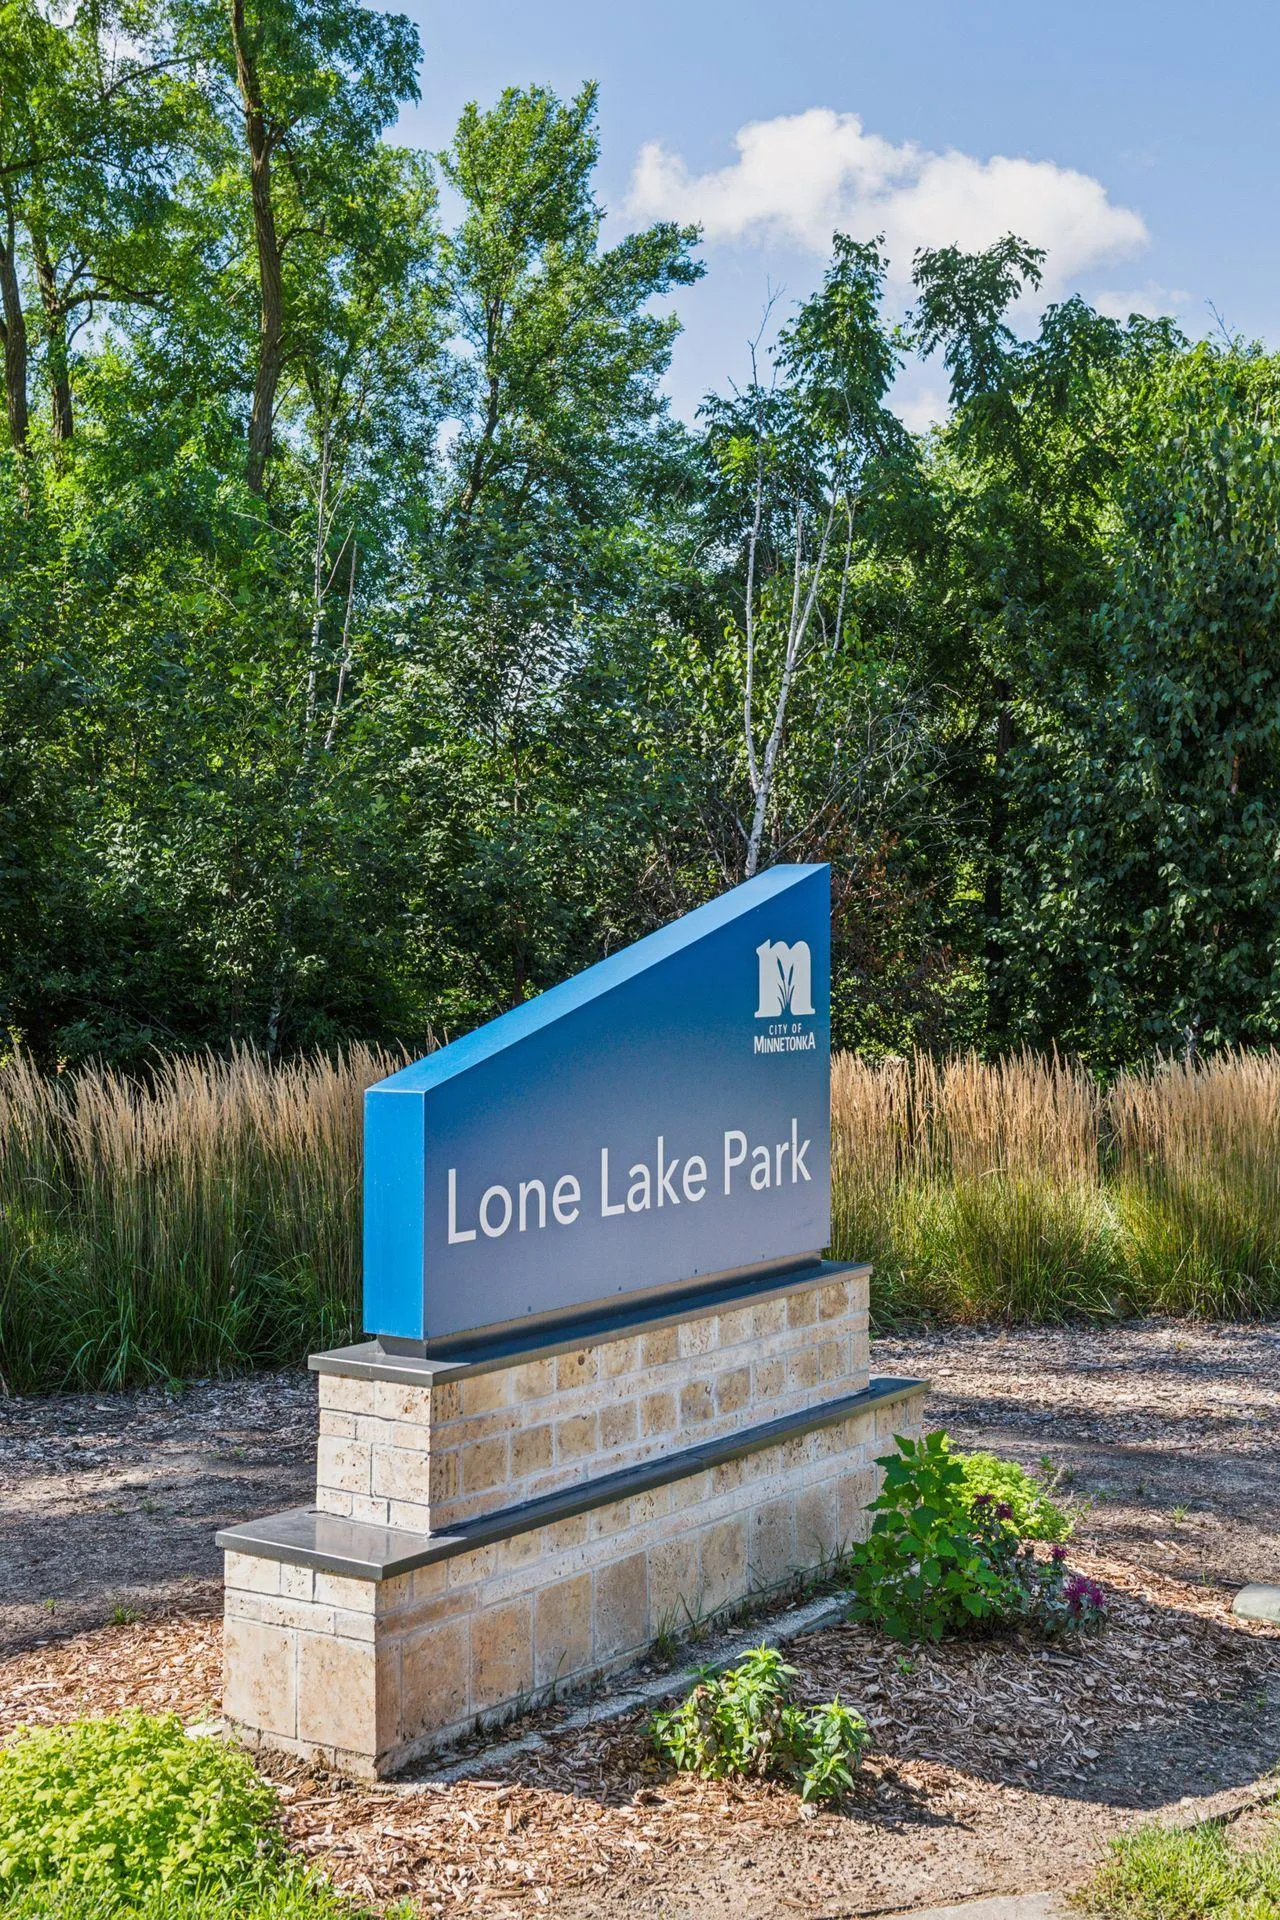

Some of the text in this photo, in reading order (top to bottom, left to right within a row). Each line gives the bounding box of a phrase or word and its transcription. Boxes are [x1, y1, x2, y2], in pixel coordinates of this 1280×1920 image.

[768, 1022, 802, 1036] CITY OF
[448, 1118, 812, 1245] Lone Lake Park
